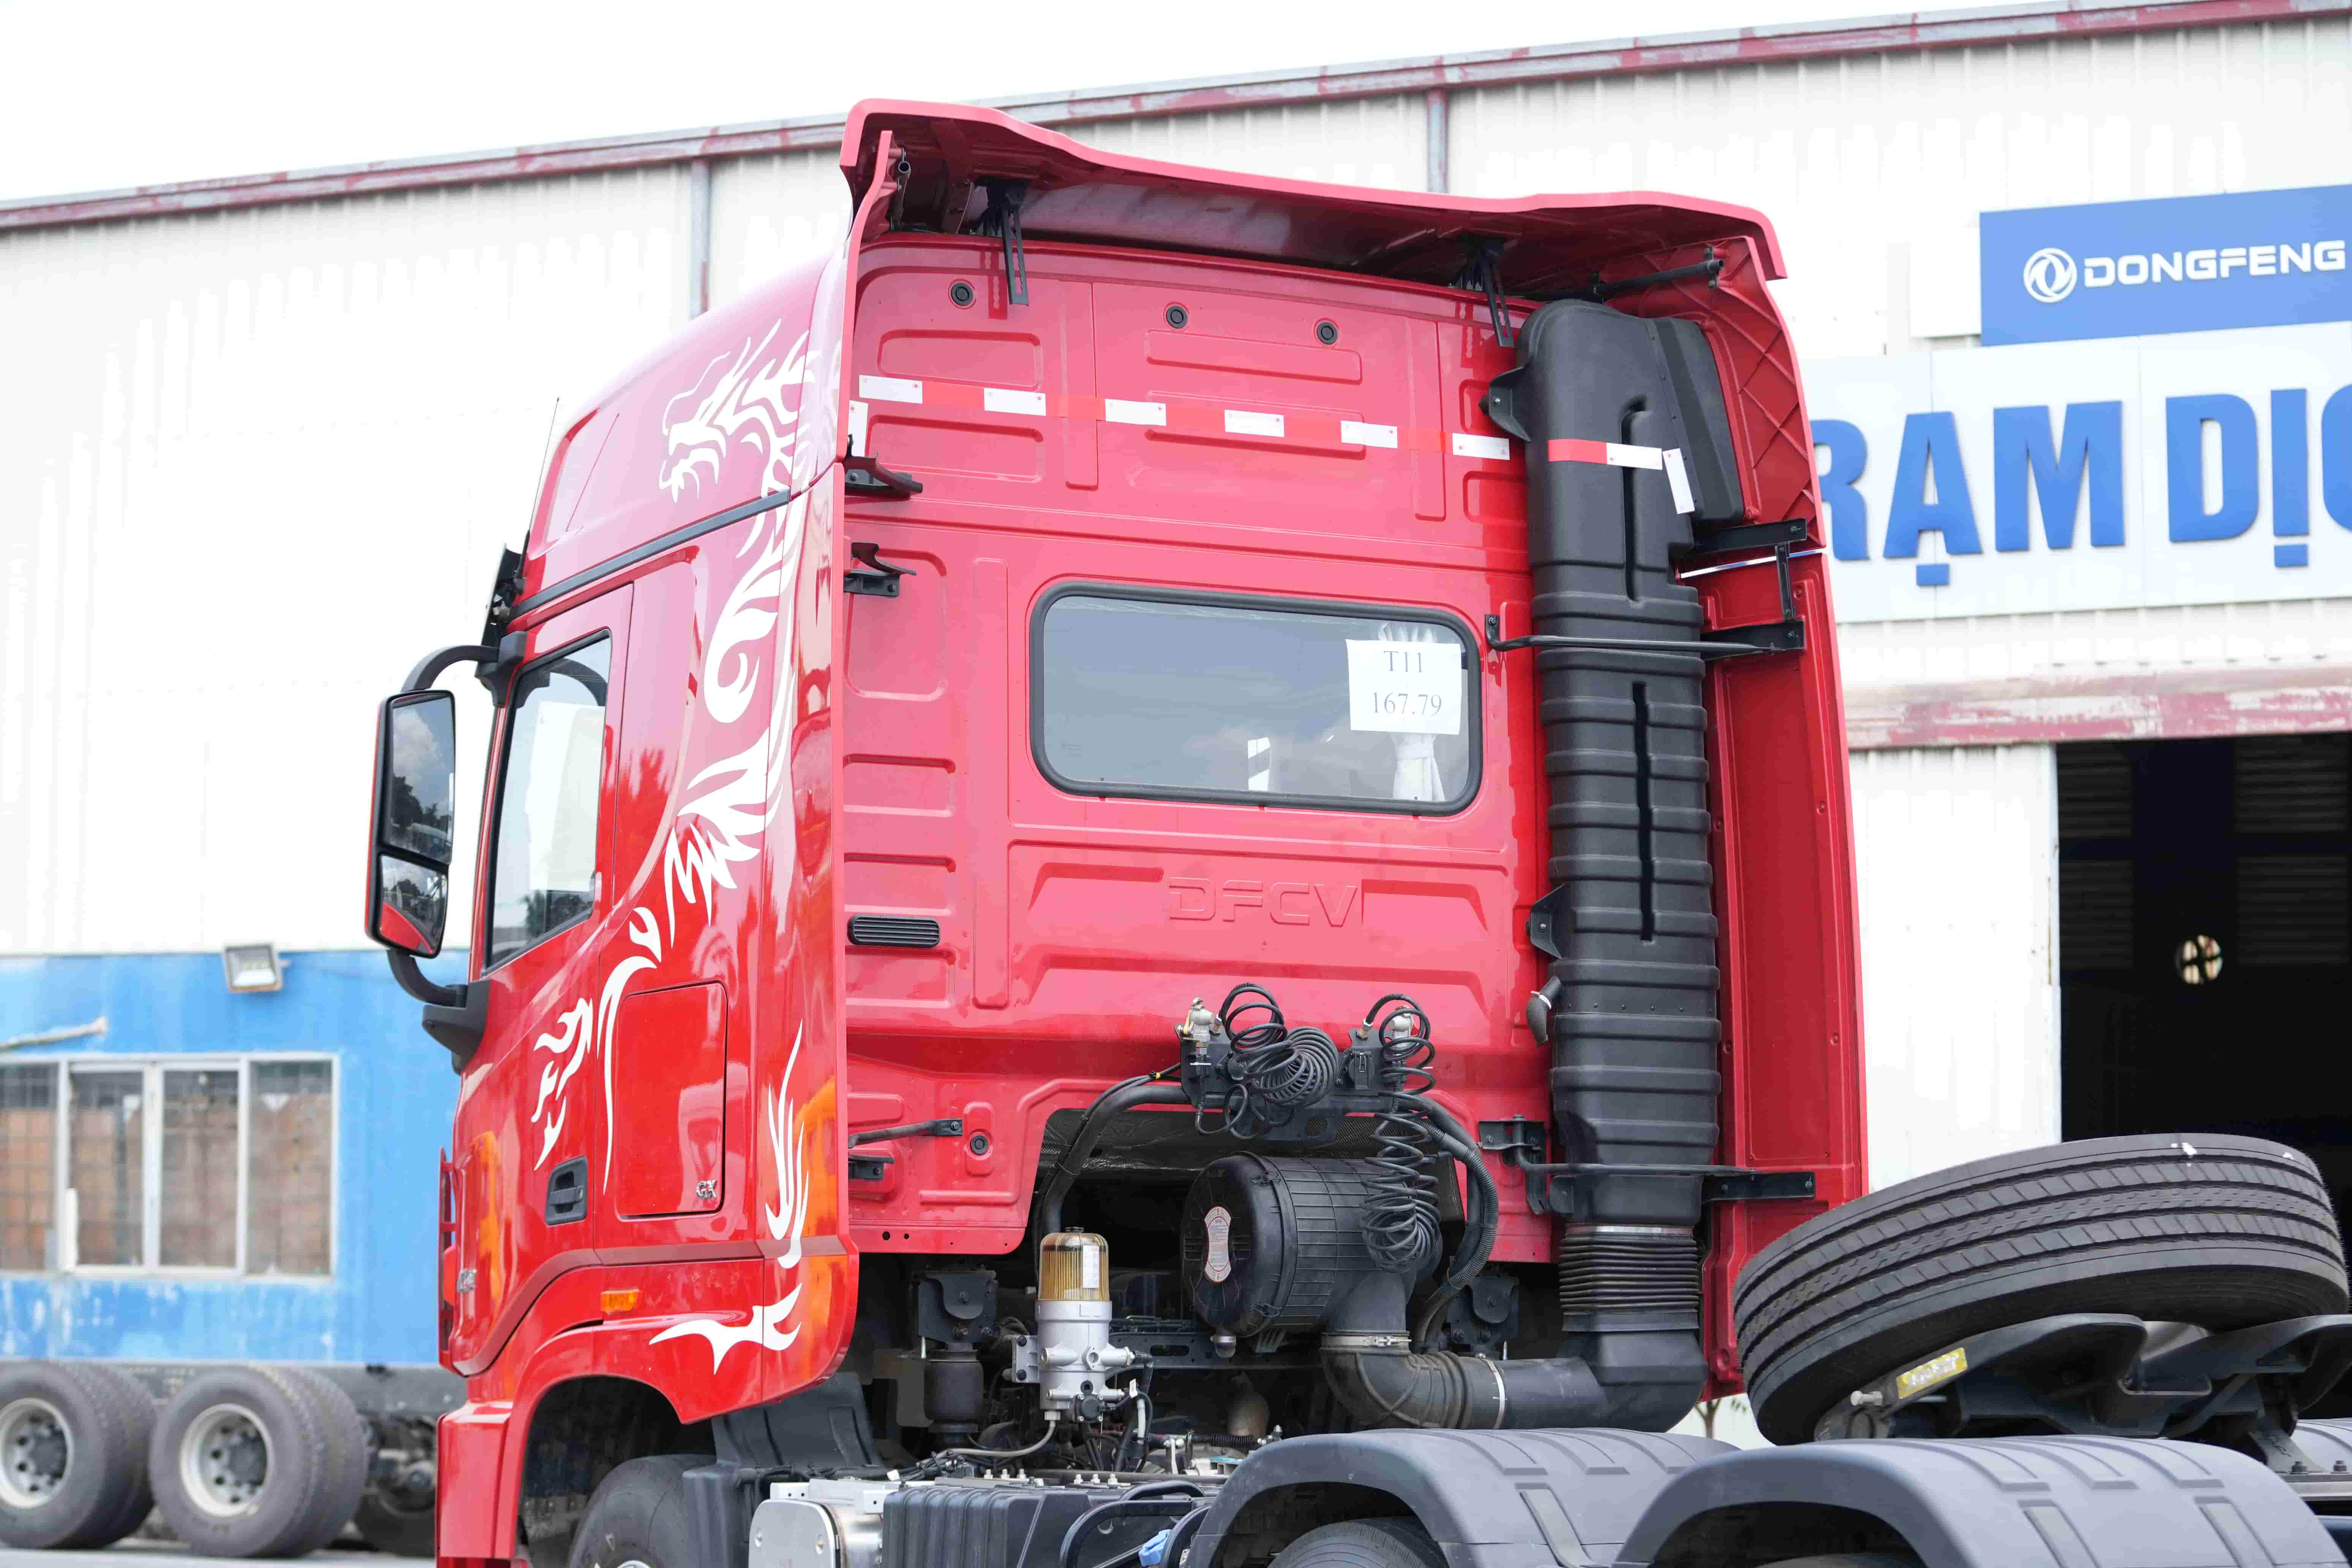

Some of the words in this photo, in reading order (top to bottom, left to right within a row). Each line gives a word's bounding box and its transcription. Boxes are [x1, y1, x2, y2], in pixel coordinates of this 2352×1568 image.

[2084, 240, 2346, 287] DONGFENG
[1383, 651, 1423, 673] T11
[1373, 692, 1442, 716] 167.79
[1169, 877, 1358, 928] DFCV
[696, 1179, 717, 1199] GX
